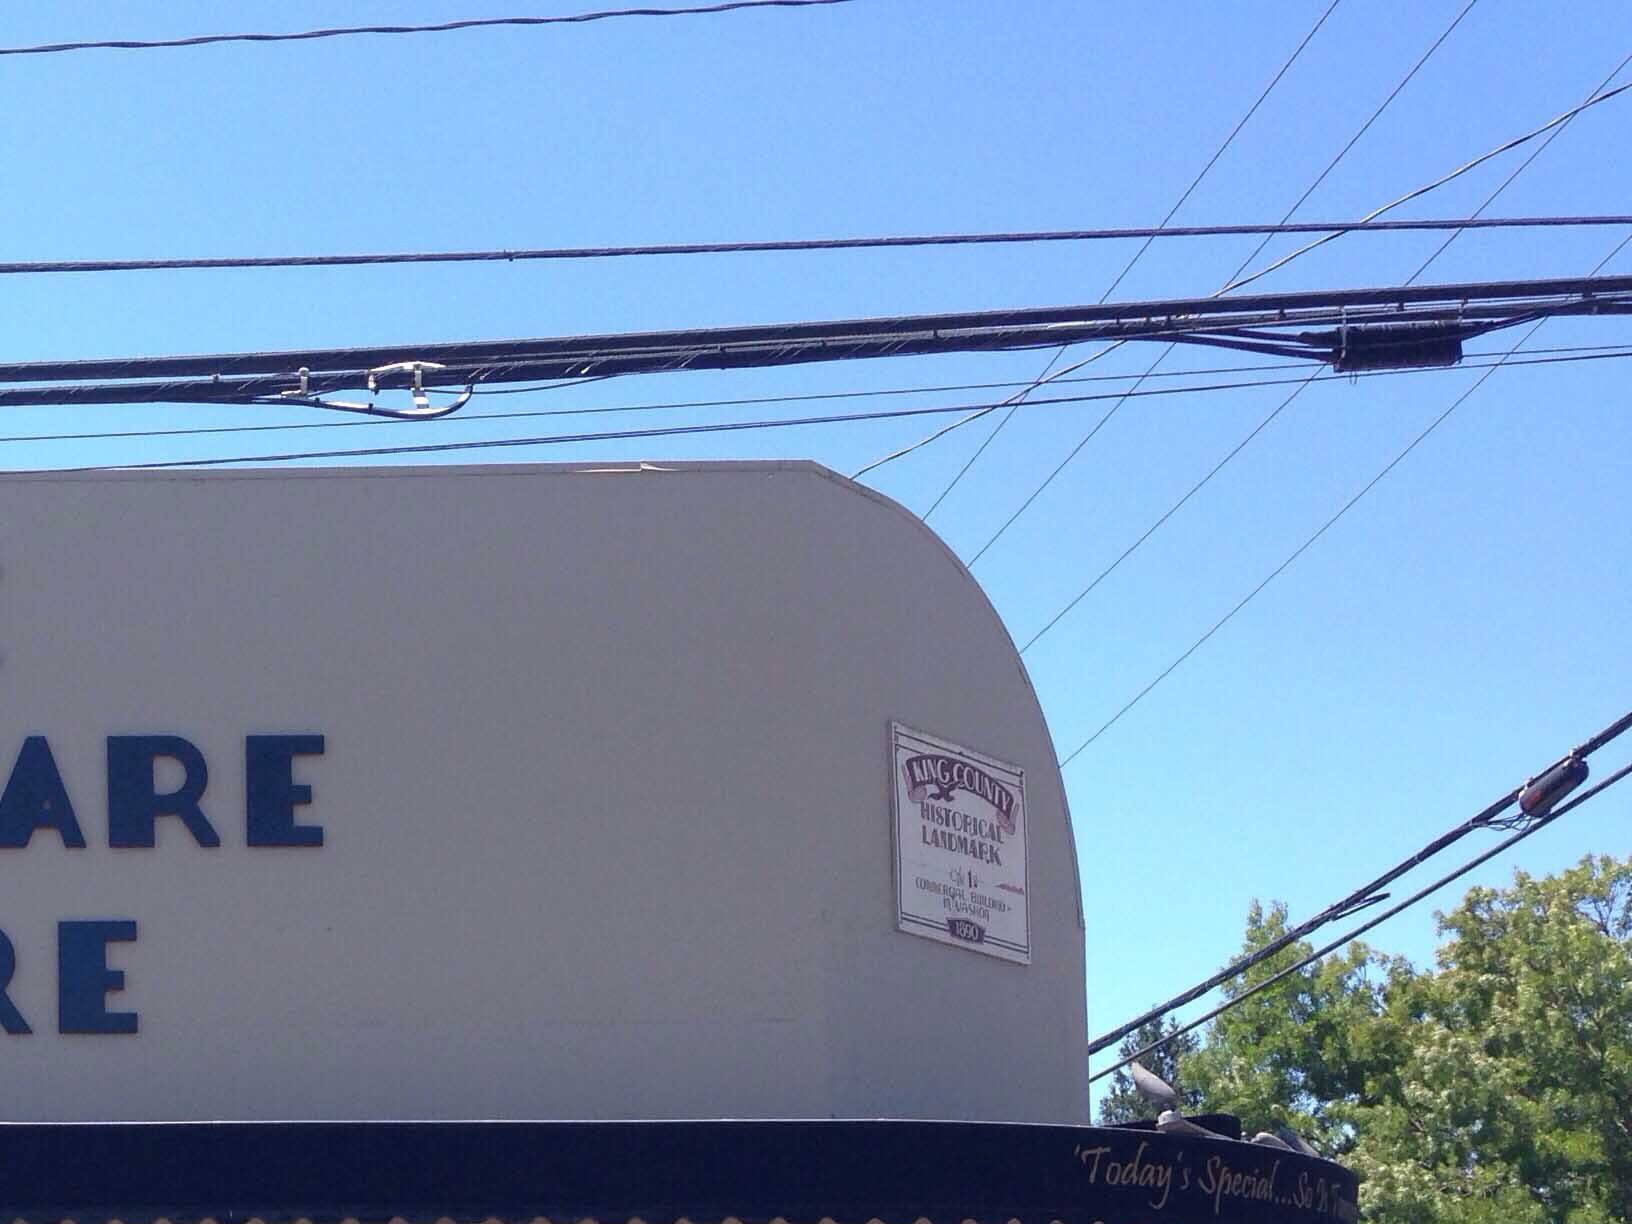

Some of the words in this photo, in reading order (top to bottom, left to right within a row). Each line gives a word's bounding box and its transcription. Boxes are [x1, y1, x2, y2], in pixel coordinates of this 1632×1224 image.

[912, 758, 950, 784] KING
[952, 762, 1011, 814] COUNTY
[920, 801, 1005, 844] HISTORICAL
[921, 824, 1002, 866] LANDMARK
